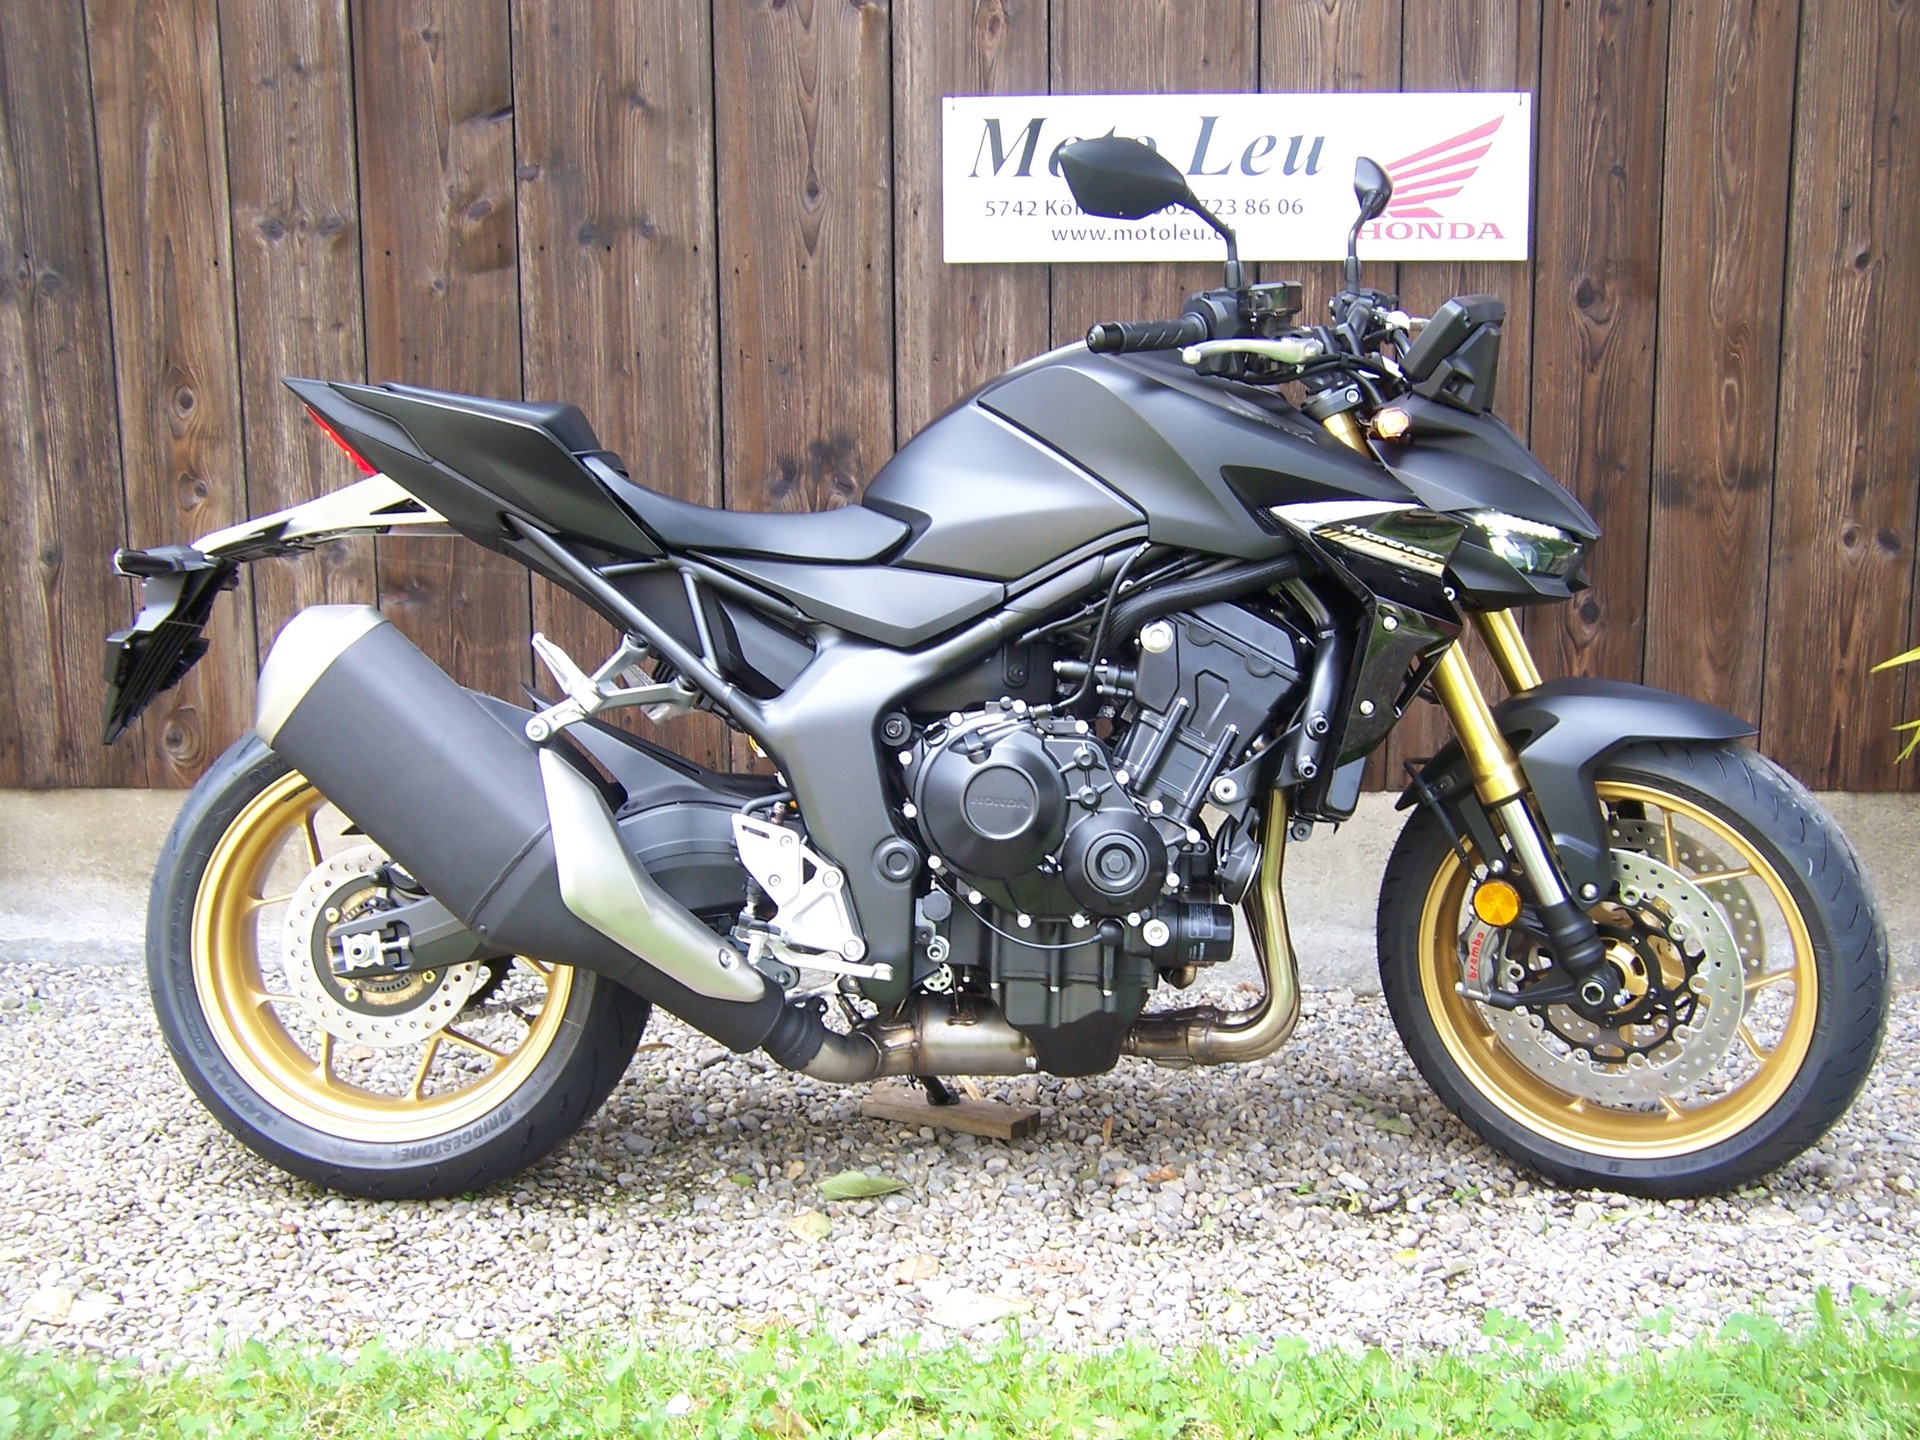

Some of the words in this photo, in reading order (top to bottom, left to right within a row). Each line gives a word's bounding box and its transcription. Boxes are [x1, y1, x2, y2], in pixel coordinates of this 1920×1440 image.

[1185, 115, 1326, 177] Leu
[985, 199, 1038, 217] 5742
[1245, 198, 1271, 215] 86
[1277, 198, 1304, 215] 06
[1357, 222, 1507, 240] HONDA
[969, 795, 1029, 809] HONDA
[1467, 932, 1485, 980] brembo
[400, 1105, 513, 1161] BRIDGESTONE
